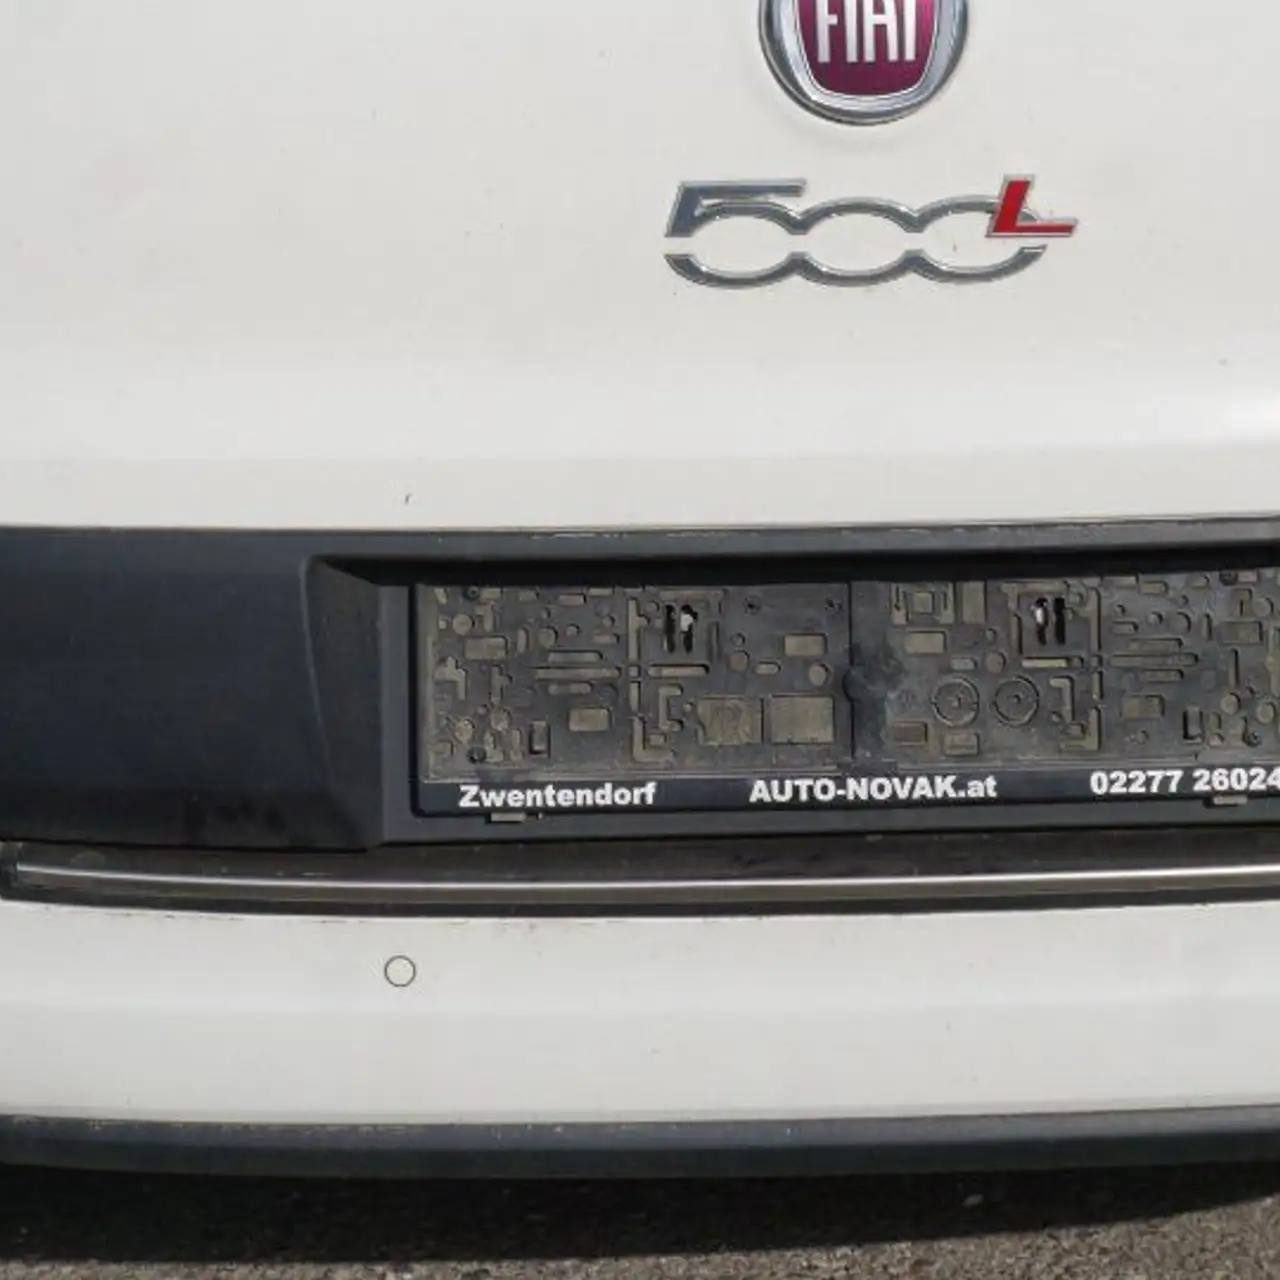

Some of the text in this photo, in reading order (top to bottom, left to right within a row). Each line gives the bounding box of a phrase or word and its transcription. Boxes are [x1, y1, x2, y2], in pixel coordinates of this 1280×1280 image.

[457, 781, 657, 809] Zwentendorf
[749, 774, 997, 803] AUTO-NOVAK.at
[1089, 768, 1184, 795] 02277
